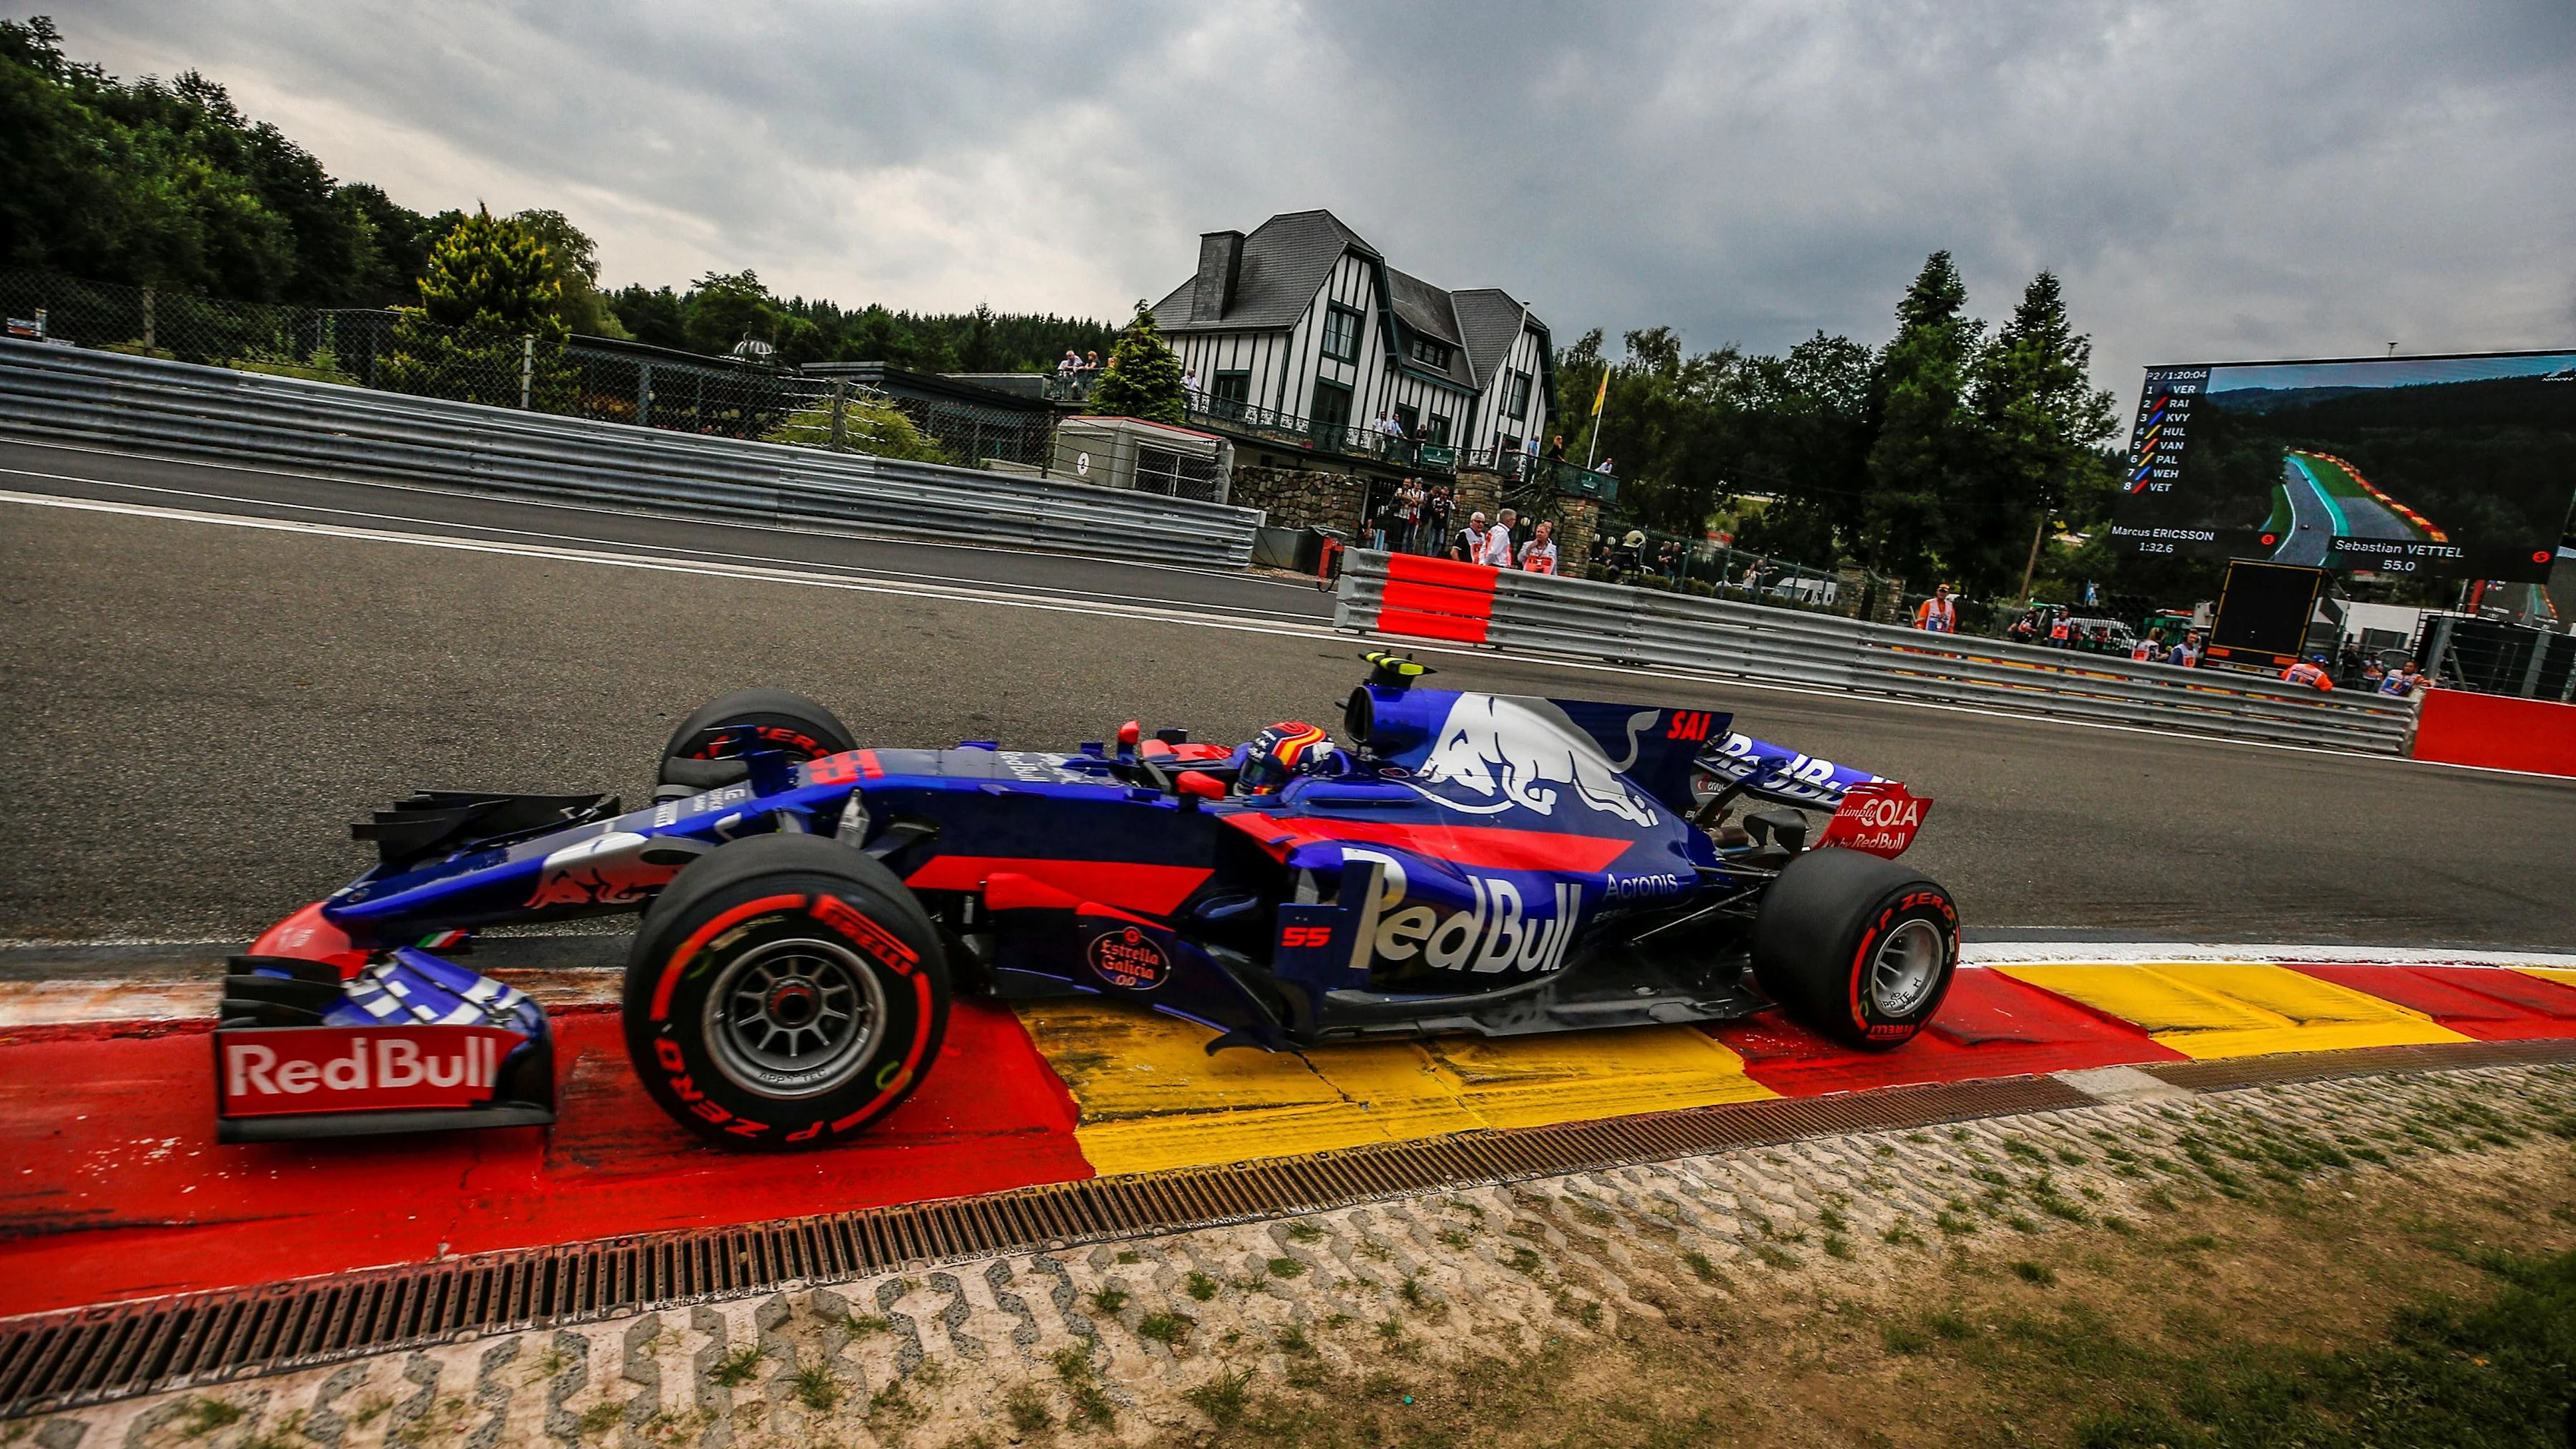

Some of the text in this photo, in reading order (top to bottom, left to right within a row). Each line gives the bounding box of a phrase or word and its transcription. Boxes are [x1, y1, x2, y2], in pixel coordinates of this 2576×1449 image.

[2147, 385, 2196, 394] 1 VER
[2143, 399, 2189, 408] 2 RAI
[2140, 413, 2190, 422] 3 KVY
[2136, 427, 2186, 436] 4 HUL
[2133, 441, 2184, 450] 5 VAN
[2130, 455, 2178, 464] 6 PAL
[2127, 468, 2179, 478] 7 WEH
[2123, 481, 2172, 491] 8 VET
[2112, 526, 2151, 537] Marcus
[2152, 528, 2215, 541] ERICSSON
[2139, 542, 2174, 553] 1:32.6
[2335, 539, 2402, 554] Sebastian
[2407, 545, 2464, 558] VETTEL
[2382, 560, 2417, 571] 55.0
[1667, 711, 1713, 741] SAI
[1836, 798, 1918, 827] simply COLA
[1602, 873, 1678, 902] Acronis
[1900, 892, 1956, 924] ZERO
[1281, 927, 1331, 947] 55
[1100, 939, 1159, 966] Estrella
[1100, 954, 1154, 980] Galicia
